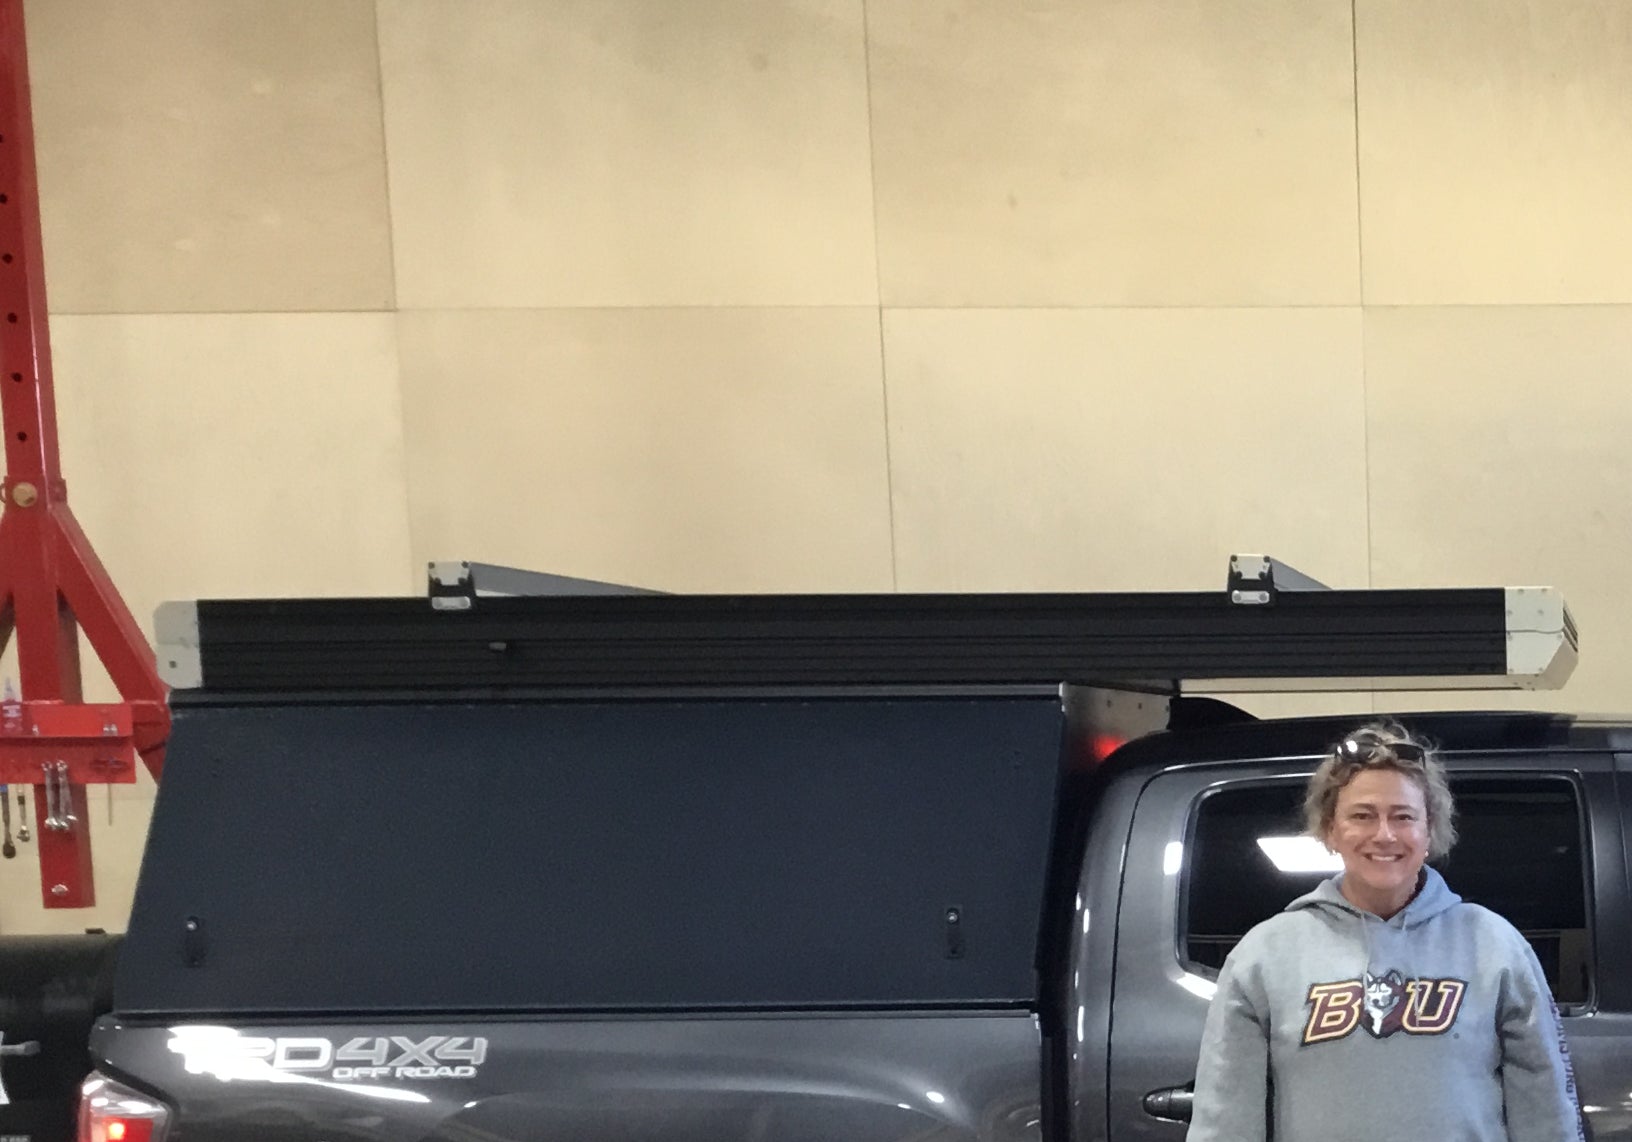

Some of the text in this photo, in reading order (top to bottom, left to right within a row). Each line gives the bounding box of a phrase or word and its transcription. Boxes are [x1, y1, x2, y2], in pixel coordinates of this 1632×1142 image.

[335, 1035, 489, 1067] 4X4
[332, 1066, 477, 1080] OFF ROAD
